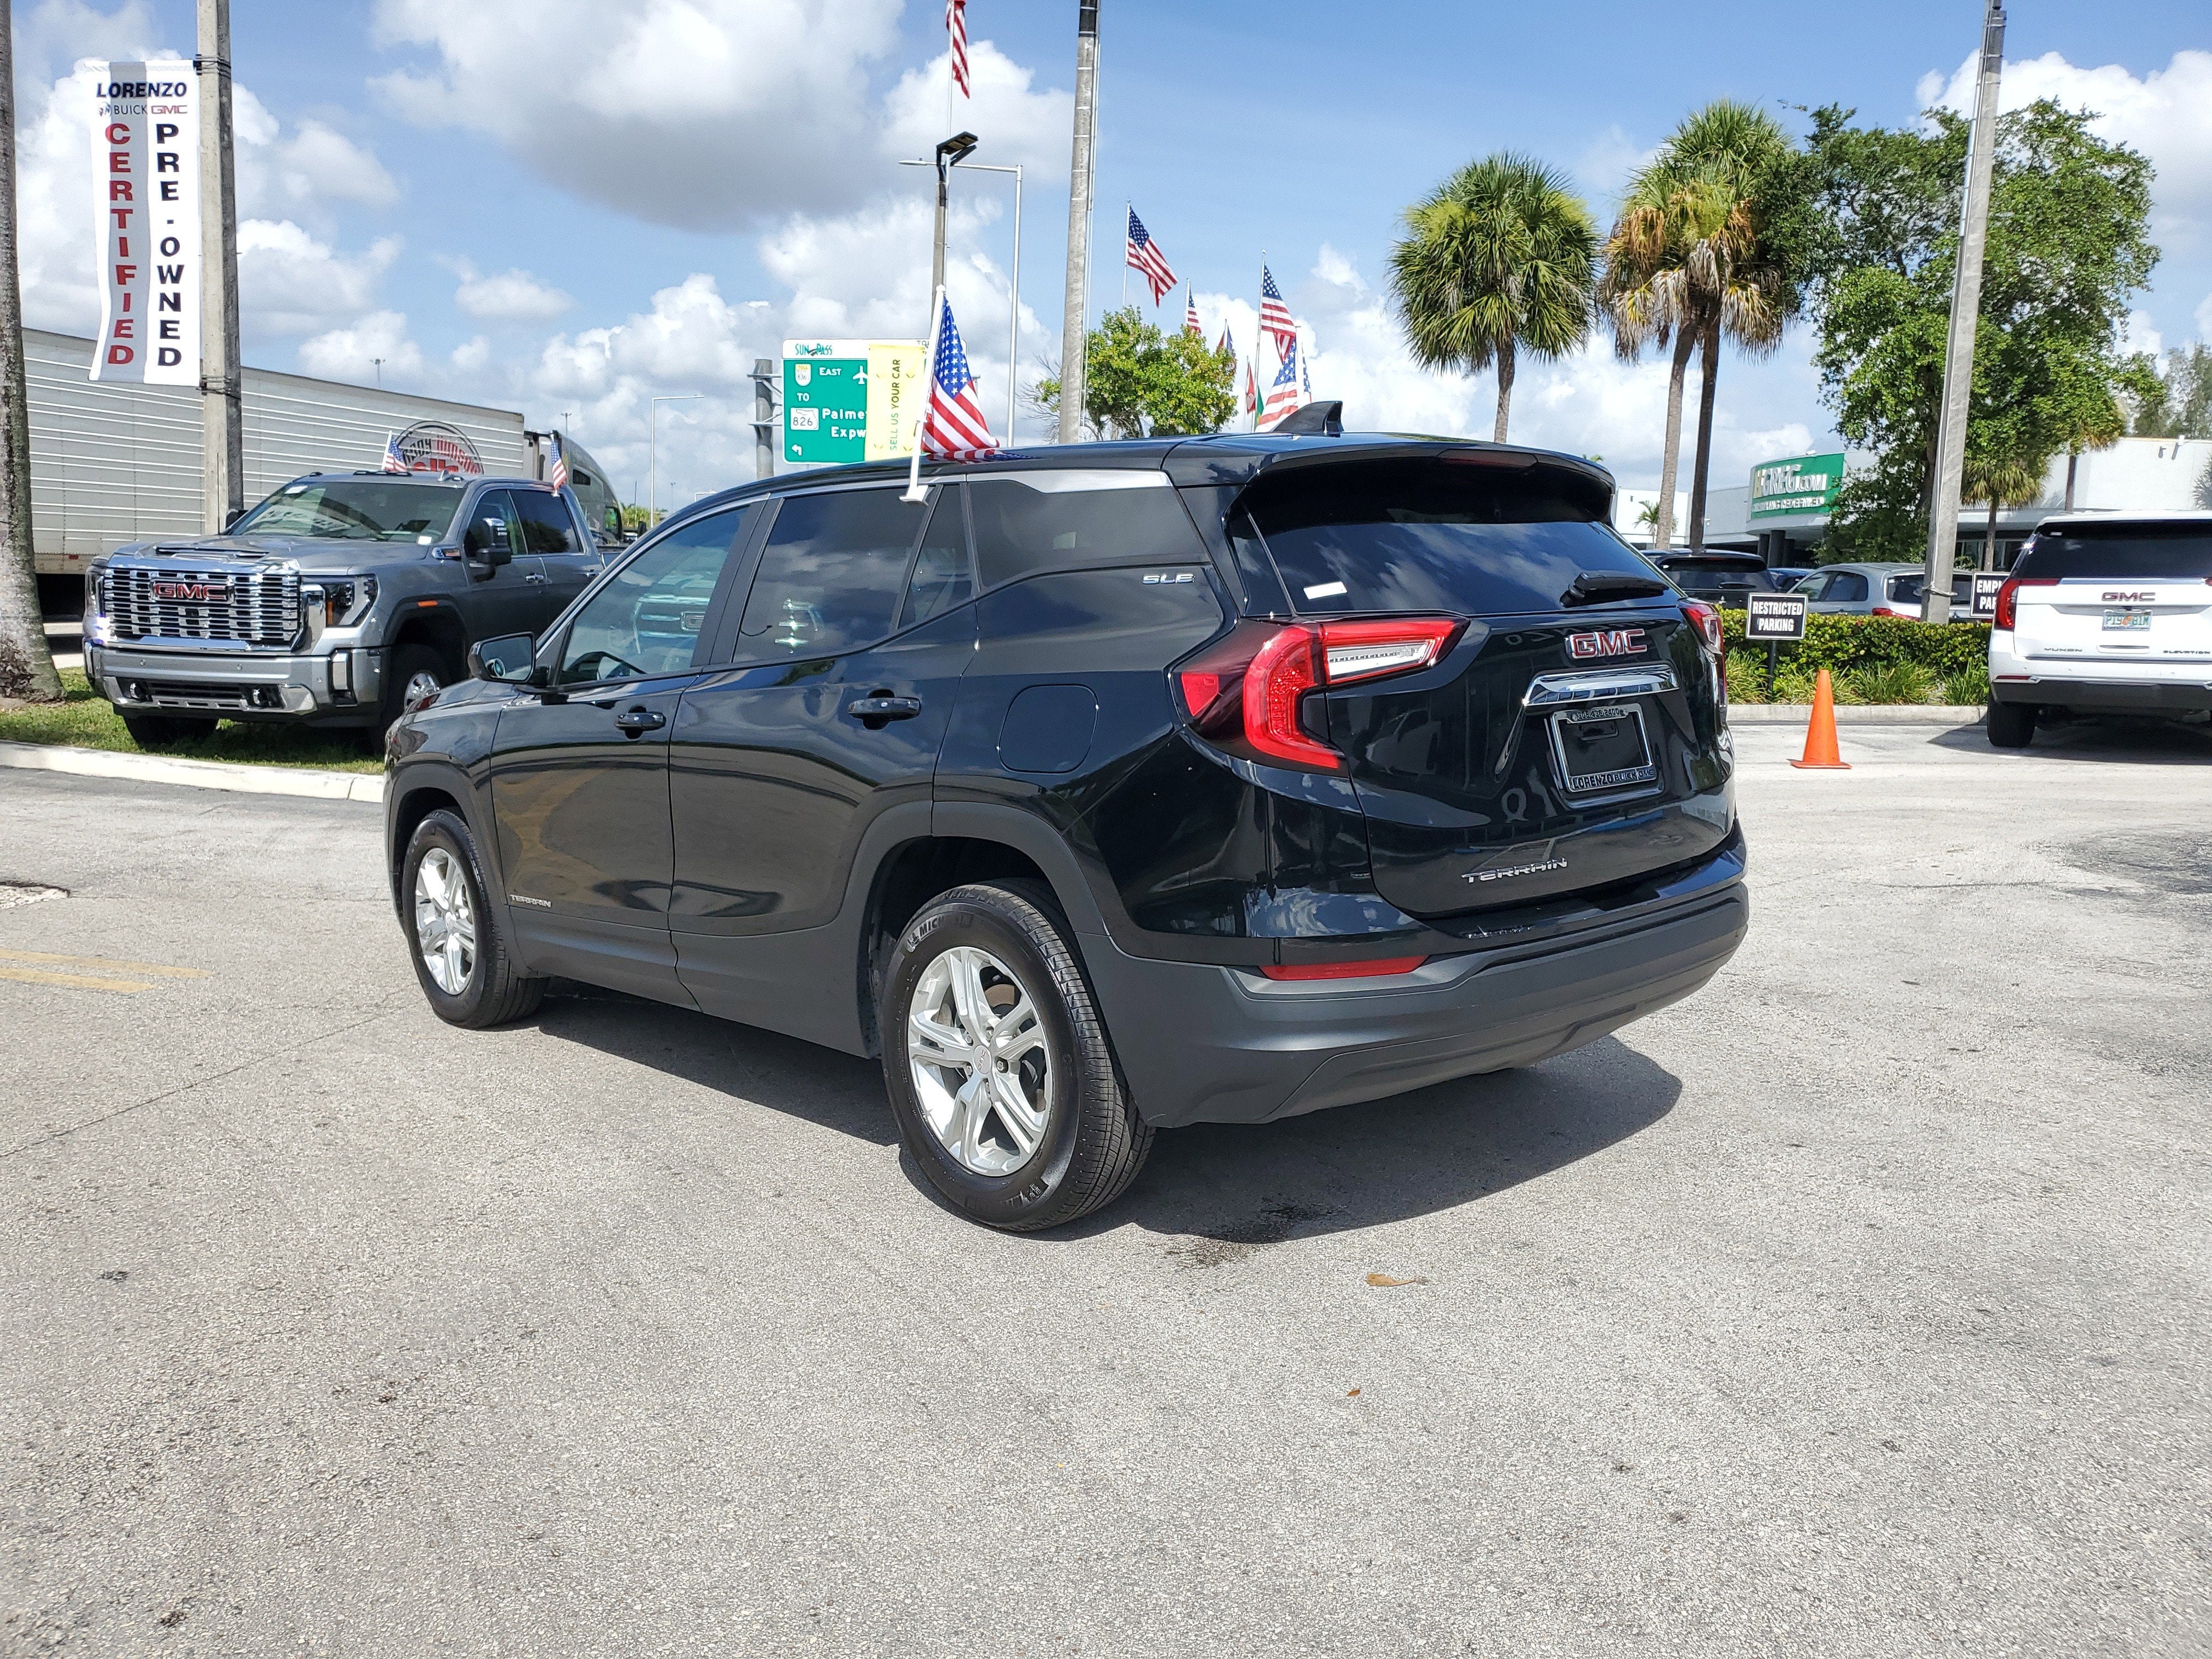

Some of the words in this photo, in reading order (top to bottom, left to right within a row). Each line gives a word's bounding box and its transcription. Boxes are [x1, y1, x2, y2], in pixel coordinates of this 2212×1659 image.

[96, 82, 187, 98] LORENZO
[114, 104, 148, 115] BUICK
[151, 105, 188, 114] GMC
[105, 123, 137, 365] CERTIFIED
[892, 359, 901, 379] CAR
[797, 392, 810, 402] TO
[891, 382, 900, 409] YOUR
[793, 416, 813, 426] 826
[822, 408, 867, 420] Palme
[890, 413, 899, 425] US
[1143, 573, 1195, 584] SLE
[154, 583, 227, 601] GMC
[2102, 592, 2155, 601] GMC
[1752, 601, 1803, 615] RESTRICTED
[1758, 618, 1795, 631] PARKING
[1566, 629, 1647, 659] GMC
[1572, 773, 1613, 789] LORENZO
[1613, 771, 1637, 782] BUICK
[1461, 857, 1568, 883] TERRAIN
[510, 894, 551, 908] TERRAIN
